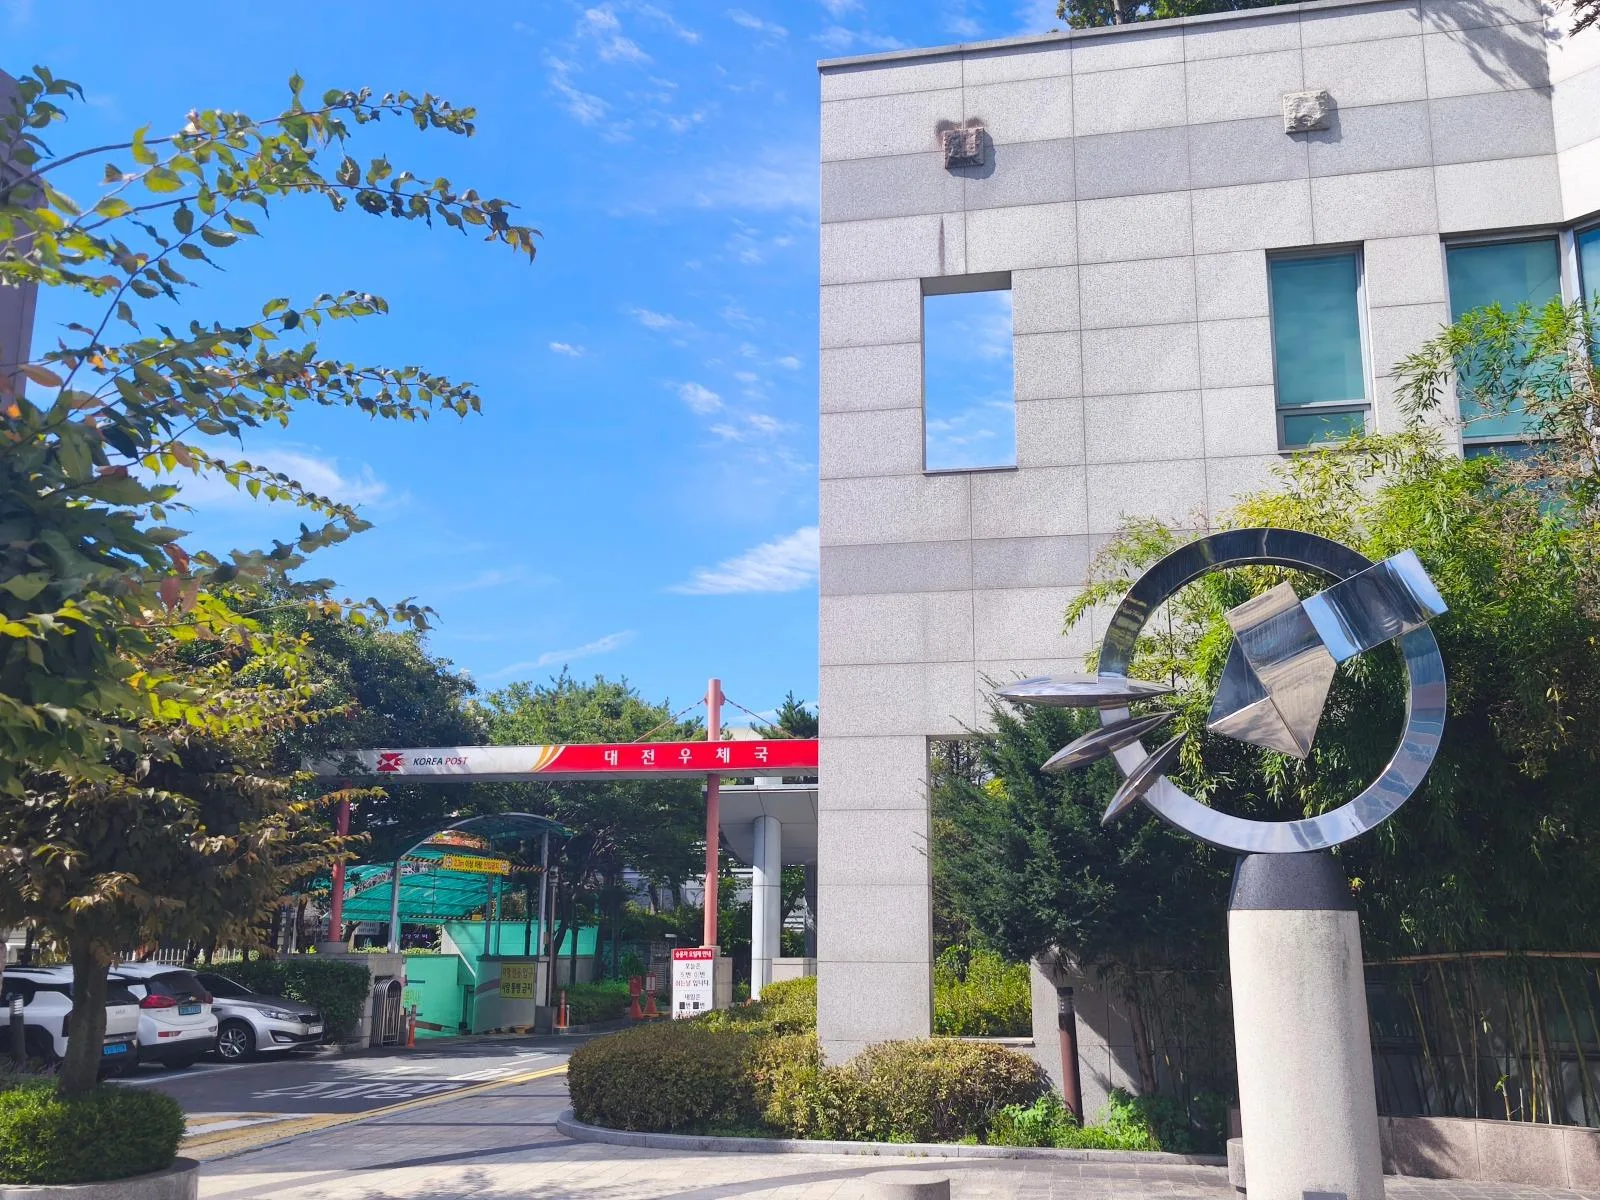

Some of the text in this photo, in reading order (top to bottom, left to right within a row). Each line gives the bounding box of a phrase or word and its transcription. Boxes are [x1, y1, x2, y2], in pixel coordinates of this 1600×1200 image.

[412, 756, 469, 766] KOREA POST
[604, 746, 769, 766] 대전우체국
